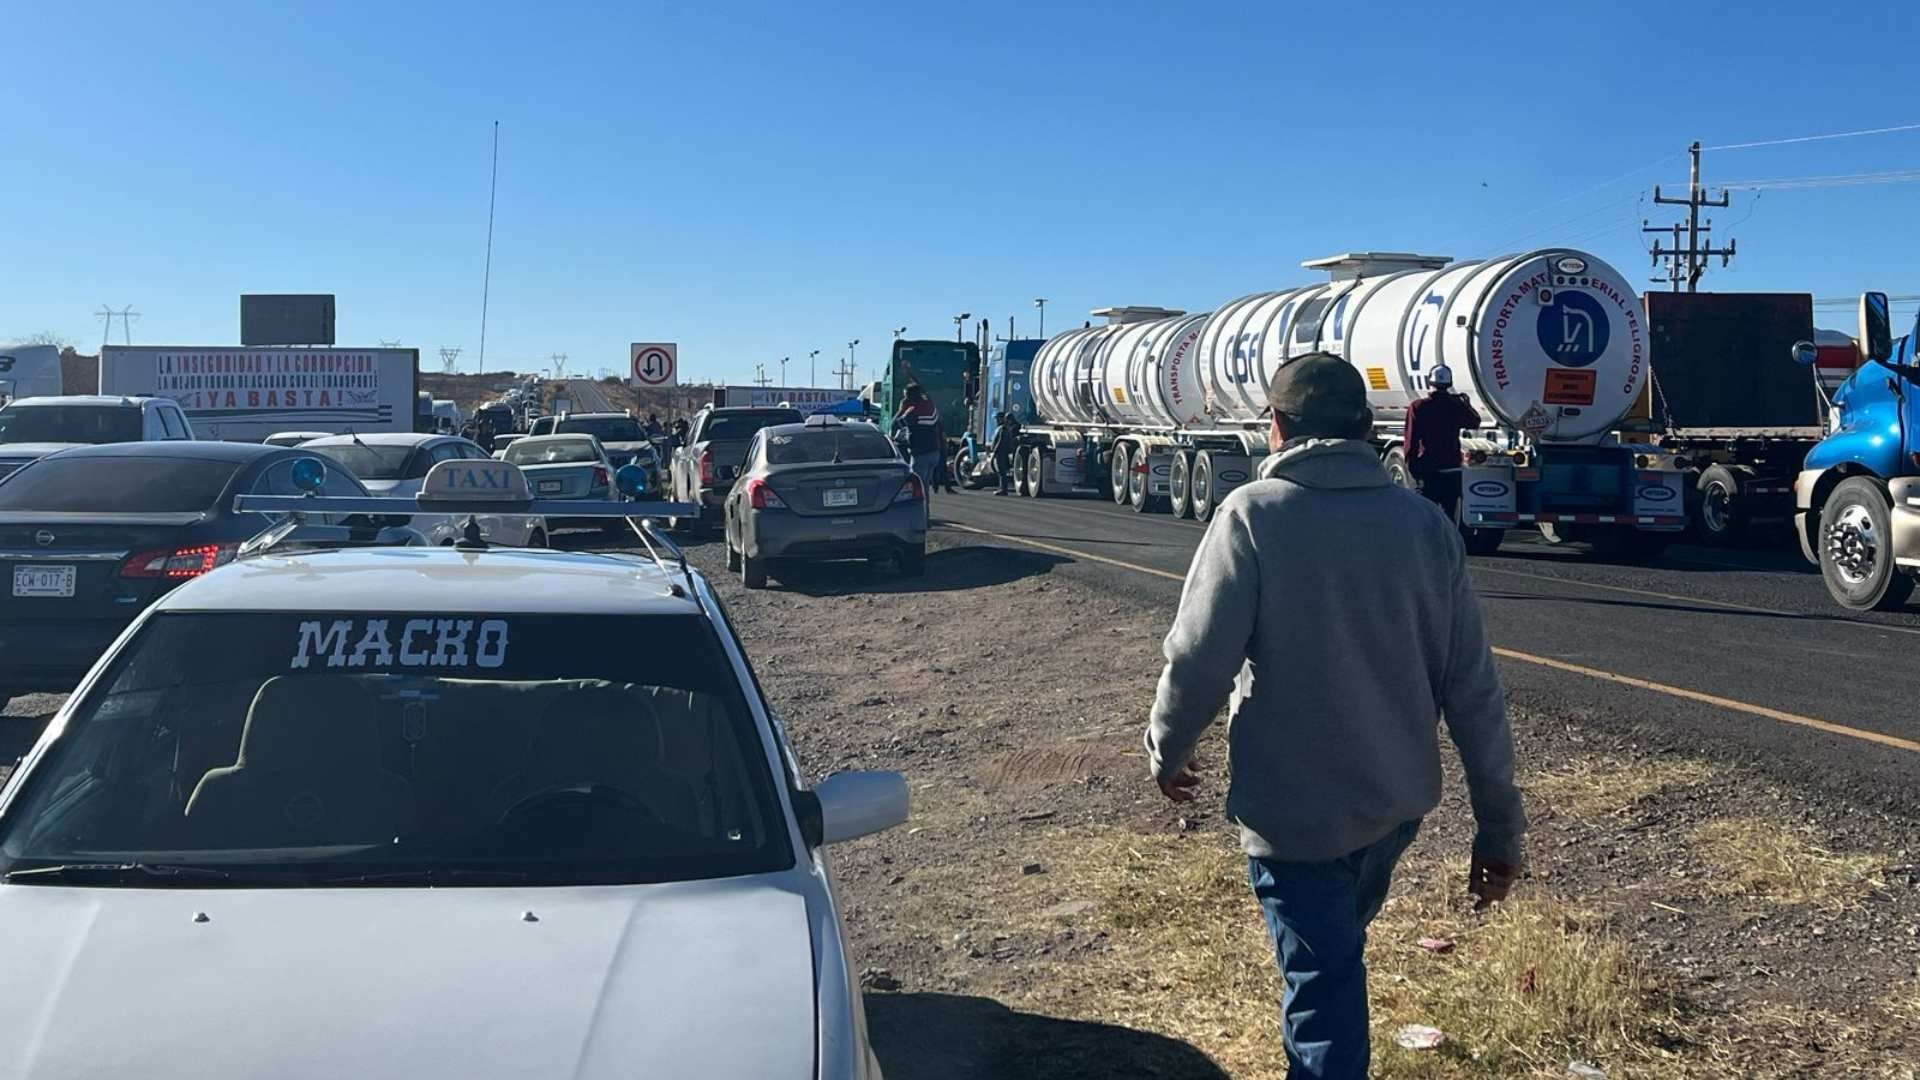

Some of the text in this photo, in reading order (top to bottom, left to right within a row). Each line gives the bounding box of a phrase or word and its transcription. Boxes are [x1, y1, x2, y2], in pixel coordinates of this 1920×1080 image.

[1491, 292, 1523, 391] TRANSPORTA
[1624, 310, 1642, 395] PELIGROSO
[158, 355, 172, 374] LA
[177, 354, 262, 373] INSEGURIDAD
[277, 355, 290, 372] LA
[1170, 341, 1191, 406] TRANSPORTA
[158, 376, 169, 390] LA
[171, 375, 202, 389] MEJOR
[322, 375, 378, 388] TRANSPORTE
[195, 390, 344, 409] ¡YA BASTA!
[788, 391, 833, 404] BASTA!
[443, 468, 512, 489] TAXI
